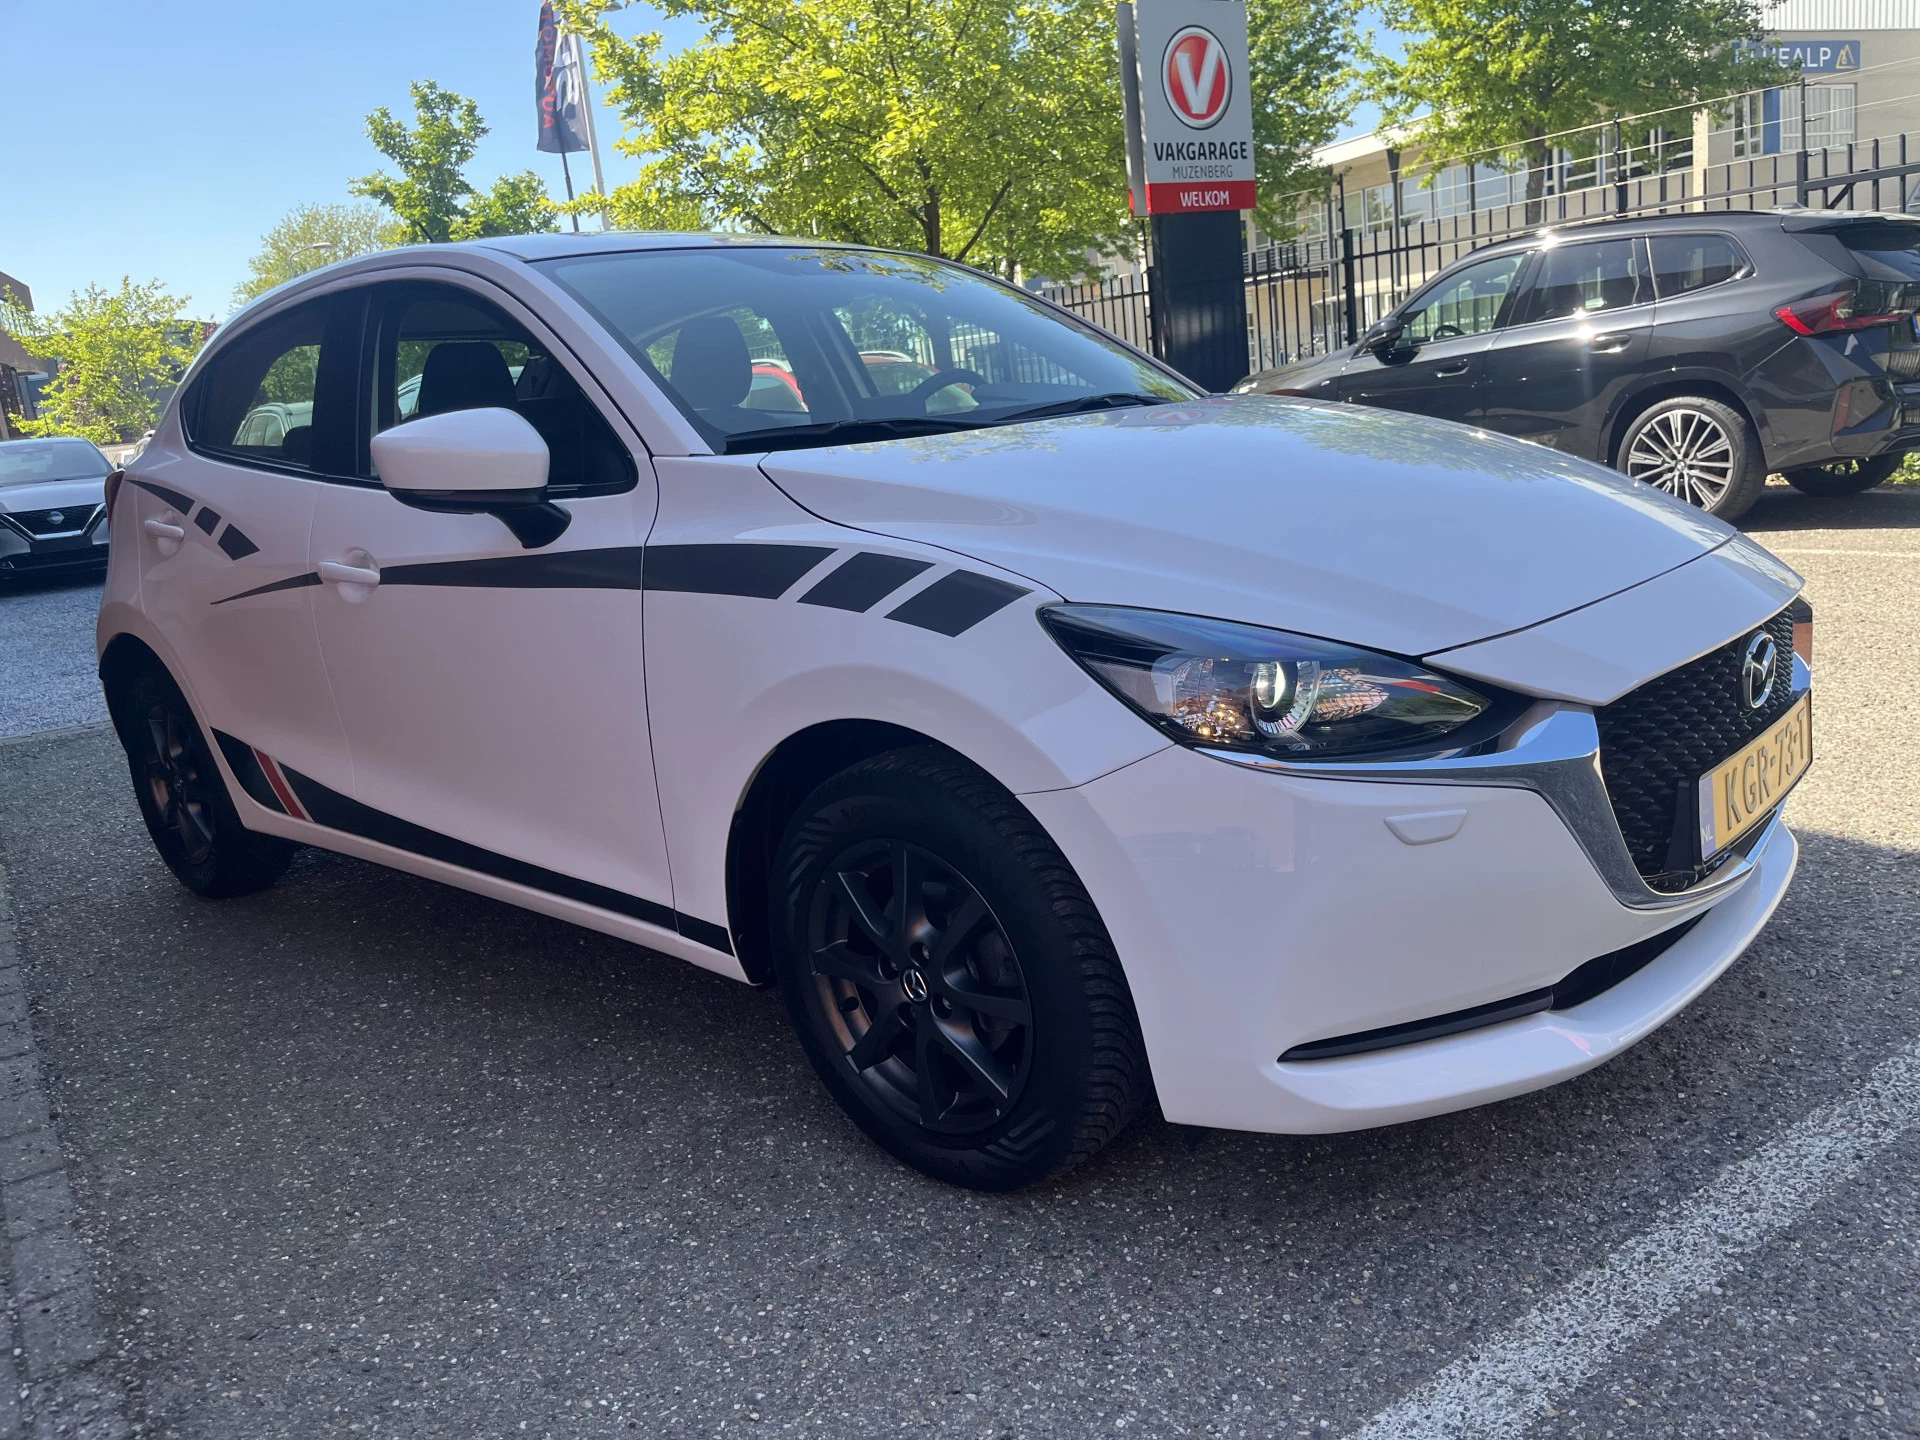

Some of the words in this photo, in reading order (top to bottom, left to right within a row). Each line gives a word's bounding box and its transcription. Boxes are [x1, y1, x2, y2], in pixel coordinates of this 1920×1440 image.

[1153, 141, 1248, 161] VAKGARAGE
[1172, 165, 1233, 179] MUZENBERG
[1180, 191, 1230, 207] WELKOM
[1701, 824, 1714, 844] NL
